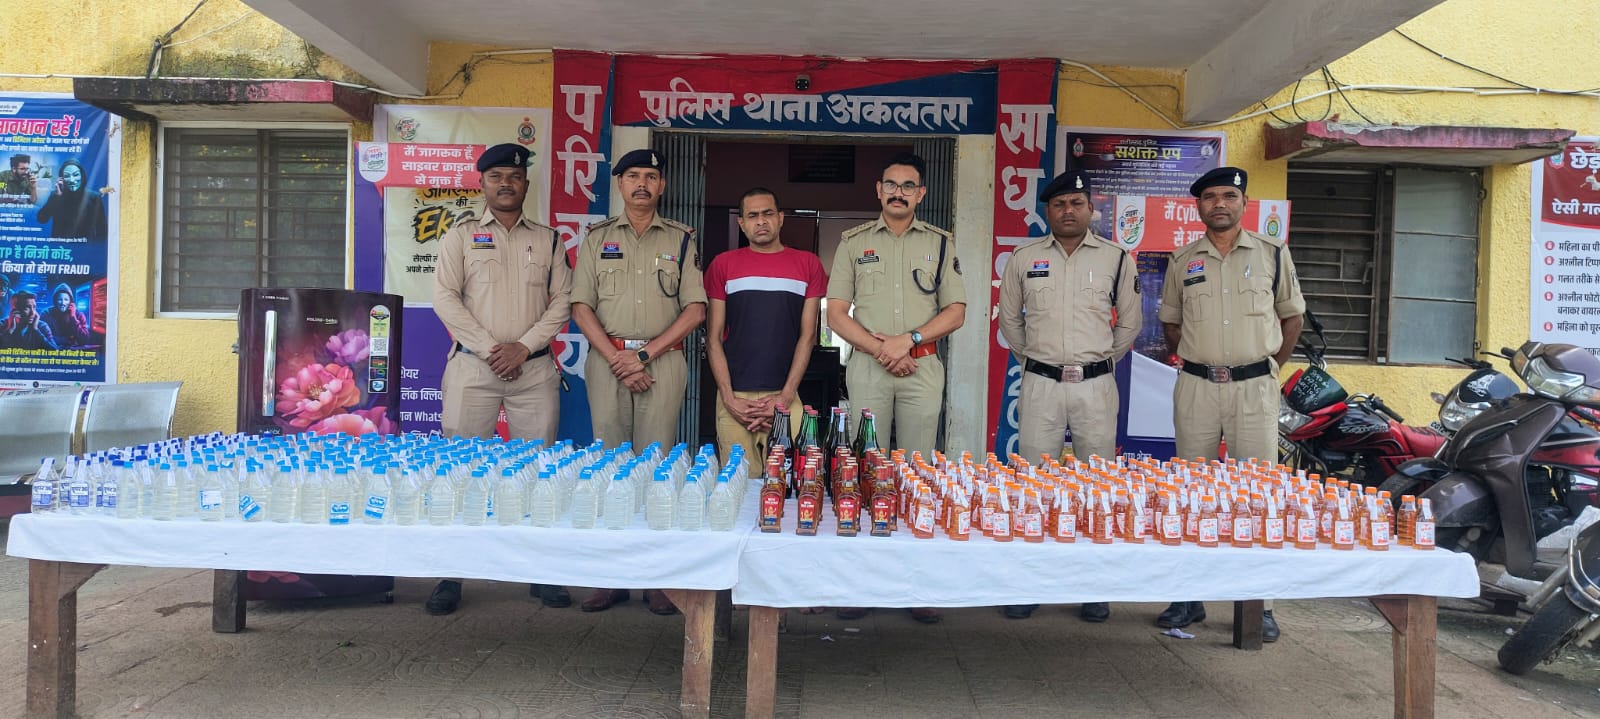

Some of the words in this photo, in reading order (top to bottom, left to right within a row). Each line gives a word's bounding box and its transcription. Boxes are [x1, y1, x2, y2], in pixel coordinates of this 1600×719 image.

[639, 77, 735, 128] पुलिस
[743, 92, 824, 124] थाना
[826, 95, 973, 131] अकलतरा
[403, 145, 416, 157] मैं
[1115, 145, 1159, 160] सशक्त
[1162, 147, 1181, 160] एप
[401, 161, 440, 172] साइबर
[441, 162, 475, 173] क्राइम
[414, 173, 427, 185] से
[455, 196, 468, 207] की
[1552, 198, 1580, 215] ऐसी
[1164, 200, 1177, 221] मैं
[1173, 226, 1185, 247] से
[14, 244, 22, 259] है
[24, 245, 49, 260] निजी
[1559, 240, 1580, 252] महिला
[1581, 242, 1591, 251] का
[412, 253, 432, 263] सेल्फी
[1558, 256, 1584, 266] अश्लील
[2, 260, 24, 273] किया
[26, 261, 36, 273] तो
[37, 261, 57, 274] होगा
[58, 263, 90, 275] FRAUD
[405, 264, 422, 273] अपने
[1558, 275, 1575, 283] गलत
[1576, 273, 1593, 284] तरीके
[1558, 291, 1583, 302] अश्लील
[1557, 306, 1580, 315] बनाकर
[1557, 320, 1578, 332] महिला
[1579, 321, 1589, 331] को
